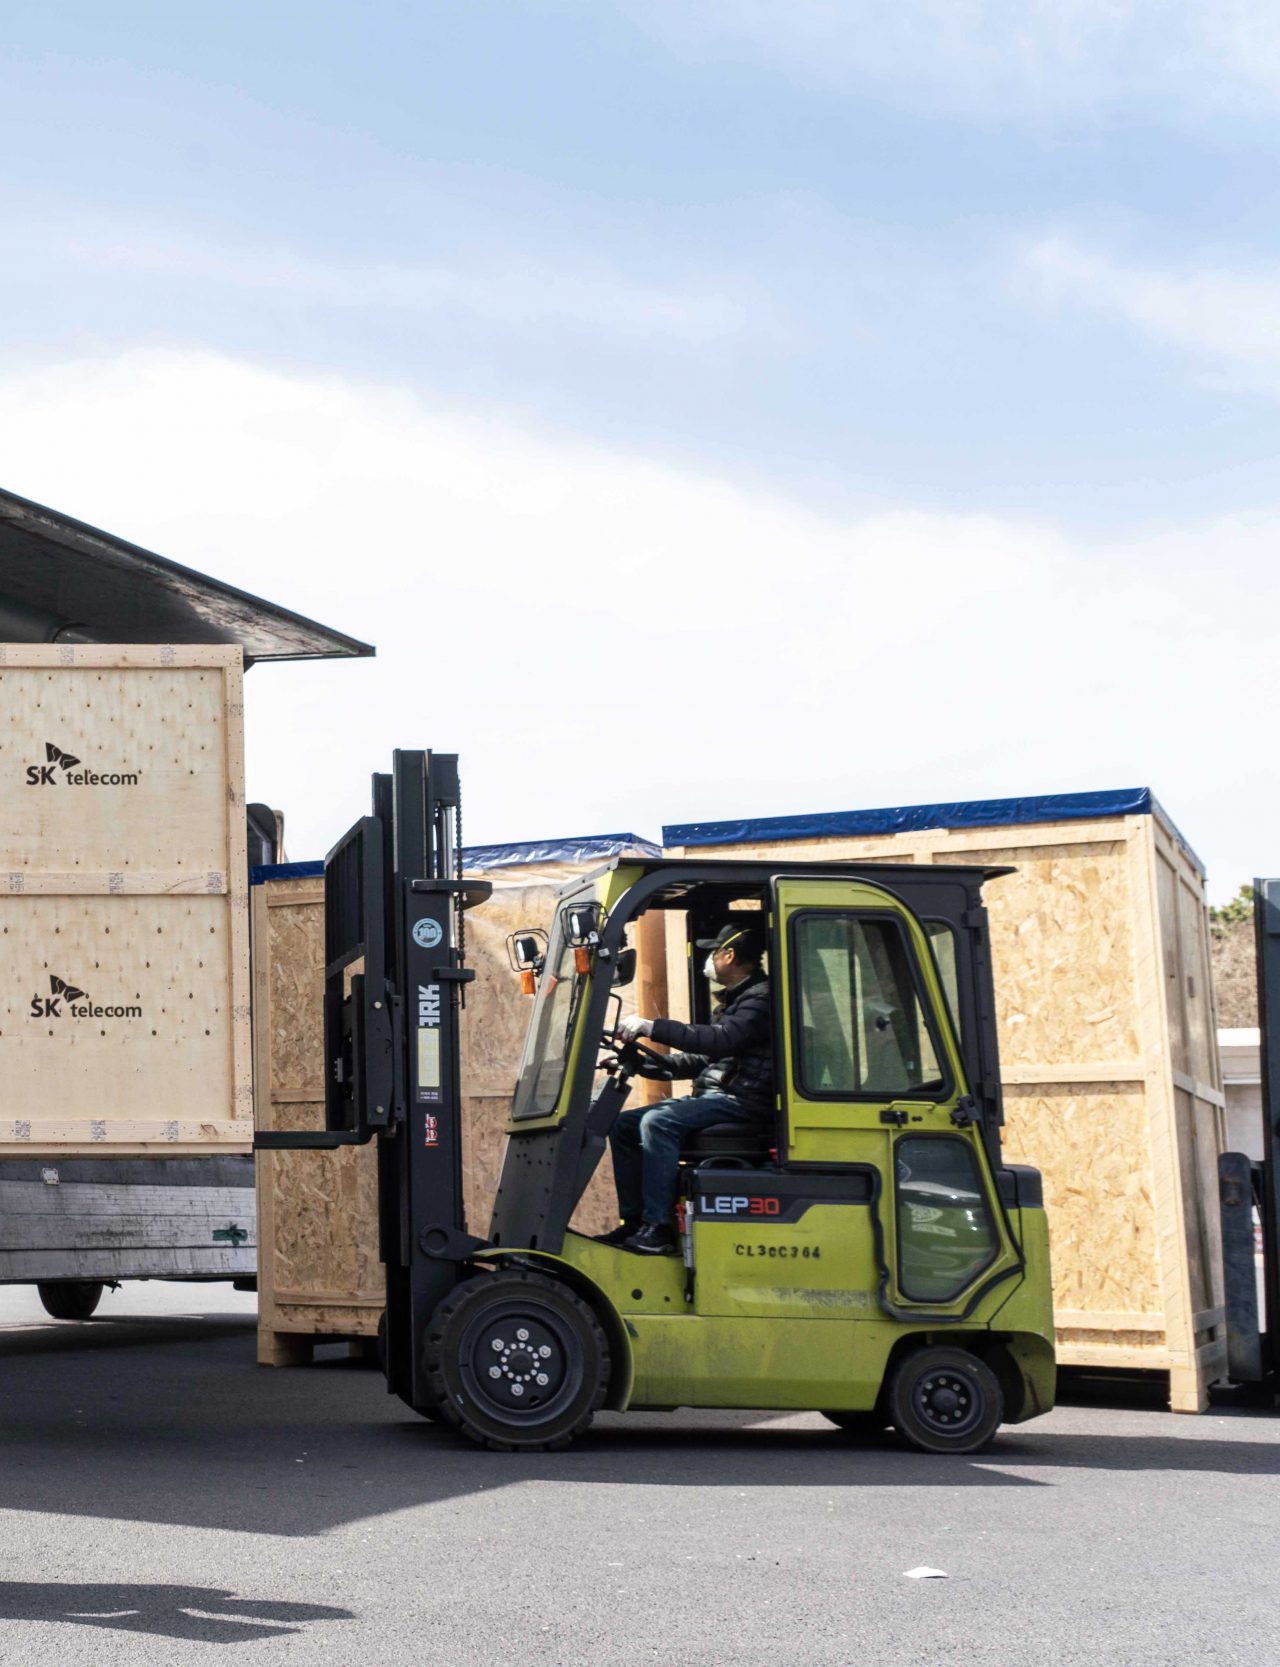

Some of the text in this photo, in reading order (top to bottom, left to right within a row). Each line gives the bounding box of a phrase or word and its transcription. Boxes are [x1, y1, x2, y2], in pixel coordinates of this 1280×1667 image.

[26, 766, 138, 785] SK telecom
[30, 998, 142, 1018] SK telecom
[701, 1196, 780, 1215] LEP30
